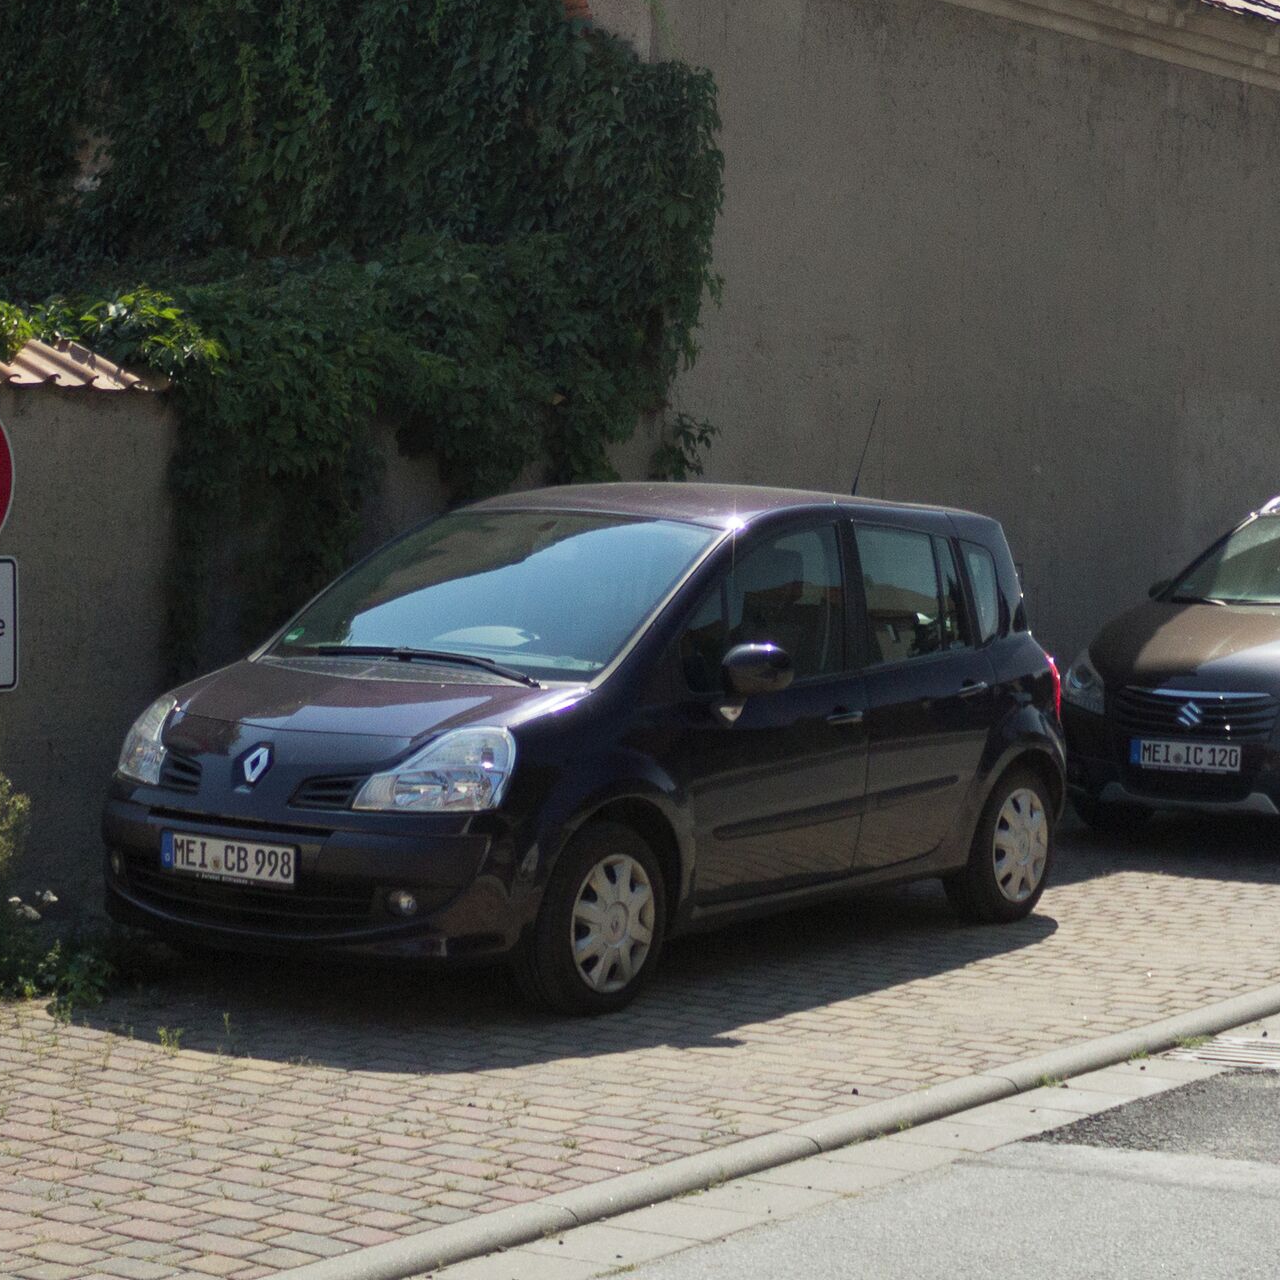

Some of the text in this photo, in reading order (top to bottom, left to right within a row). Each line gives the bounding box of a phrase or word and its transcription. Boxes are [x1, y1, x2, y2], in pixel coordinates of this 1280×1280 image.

[1142, 742, 1239, 768] MEI IC 120
[173, 837, 208, 869] MEI
[223, 844, 249, 873] CB
[254, 849, 292, 879] 998
